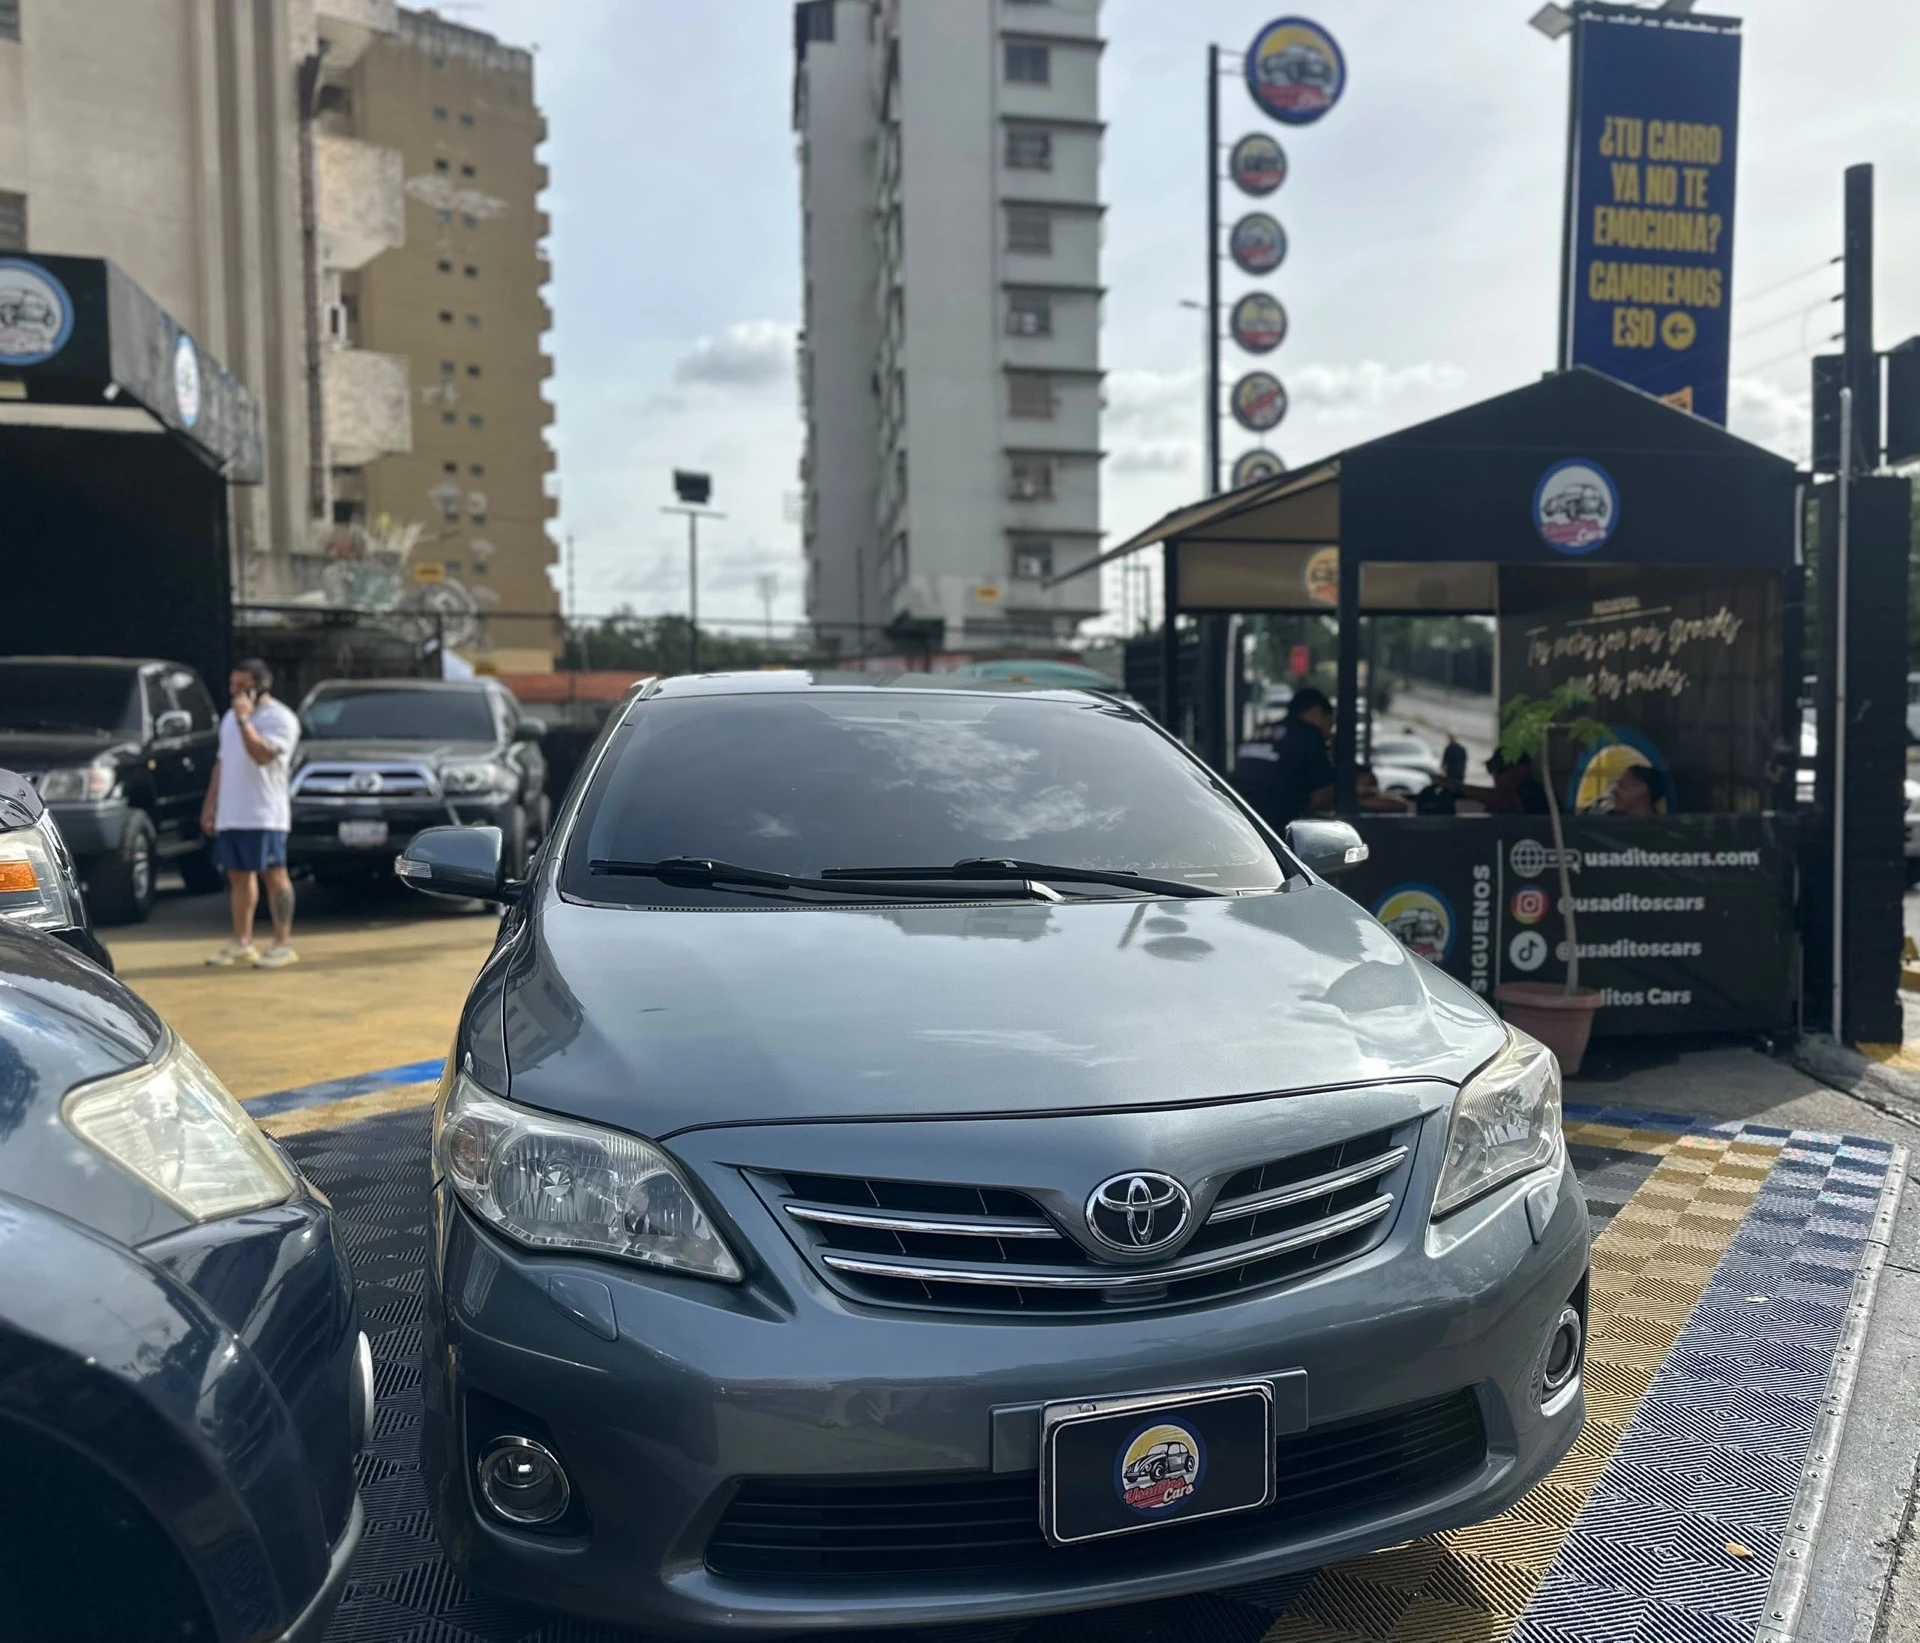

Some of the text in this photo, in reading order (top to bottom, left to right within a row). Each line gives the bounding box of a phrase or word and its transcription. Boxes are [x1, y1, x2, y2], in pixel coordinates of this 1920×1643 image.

[1599, 115, 1722, 165] ¿TU CARRO
[1610, 161, 1710, 208] YA NO TE
[1593, 205, 1723, 254] EMOCIONA?
[1588, 260, 1723, 309] CAMBIEMOS
[1612, 306, 1656, 349] ESO
[1584, 847, 1760, 868] usaditoscars.com
[1470, 864, 1491, 993] SIGUENOS
[1646, 987, 1692, 1006] Cars
[1162, 1484, 1194, 1502] Cars
